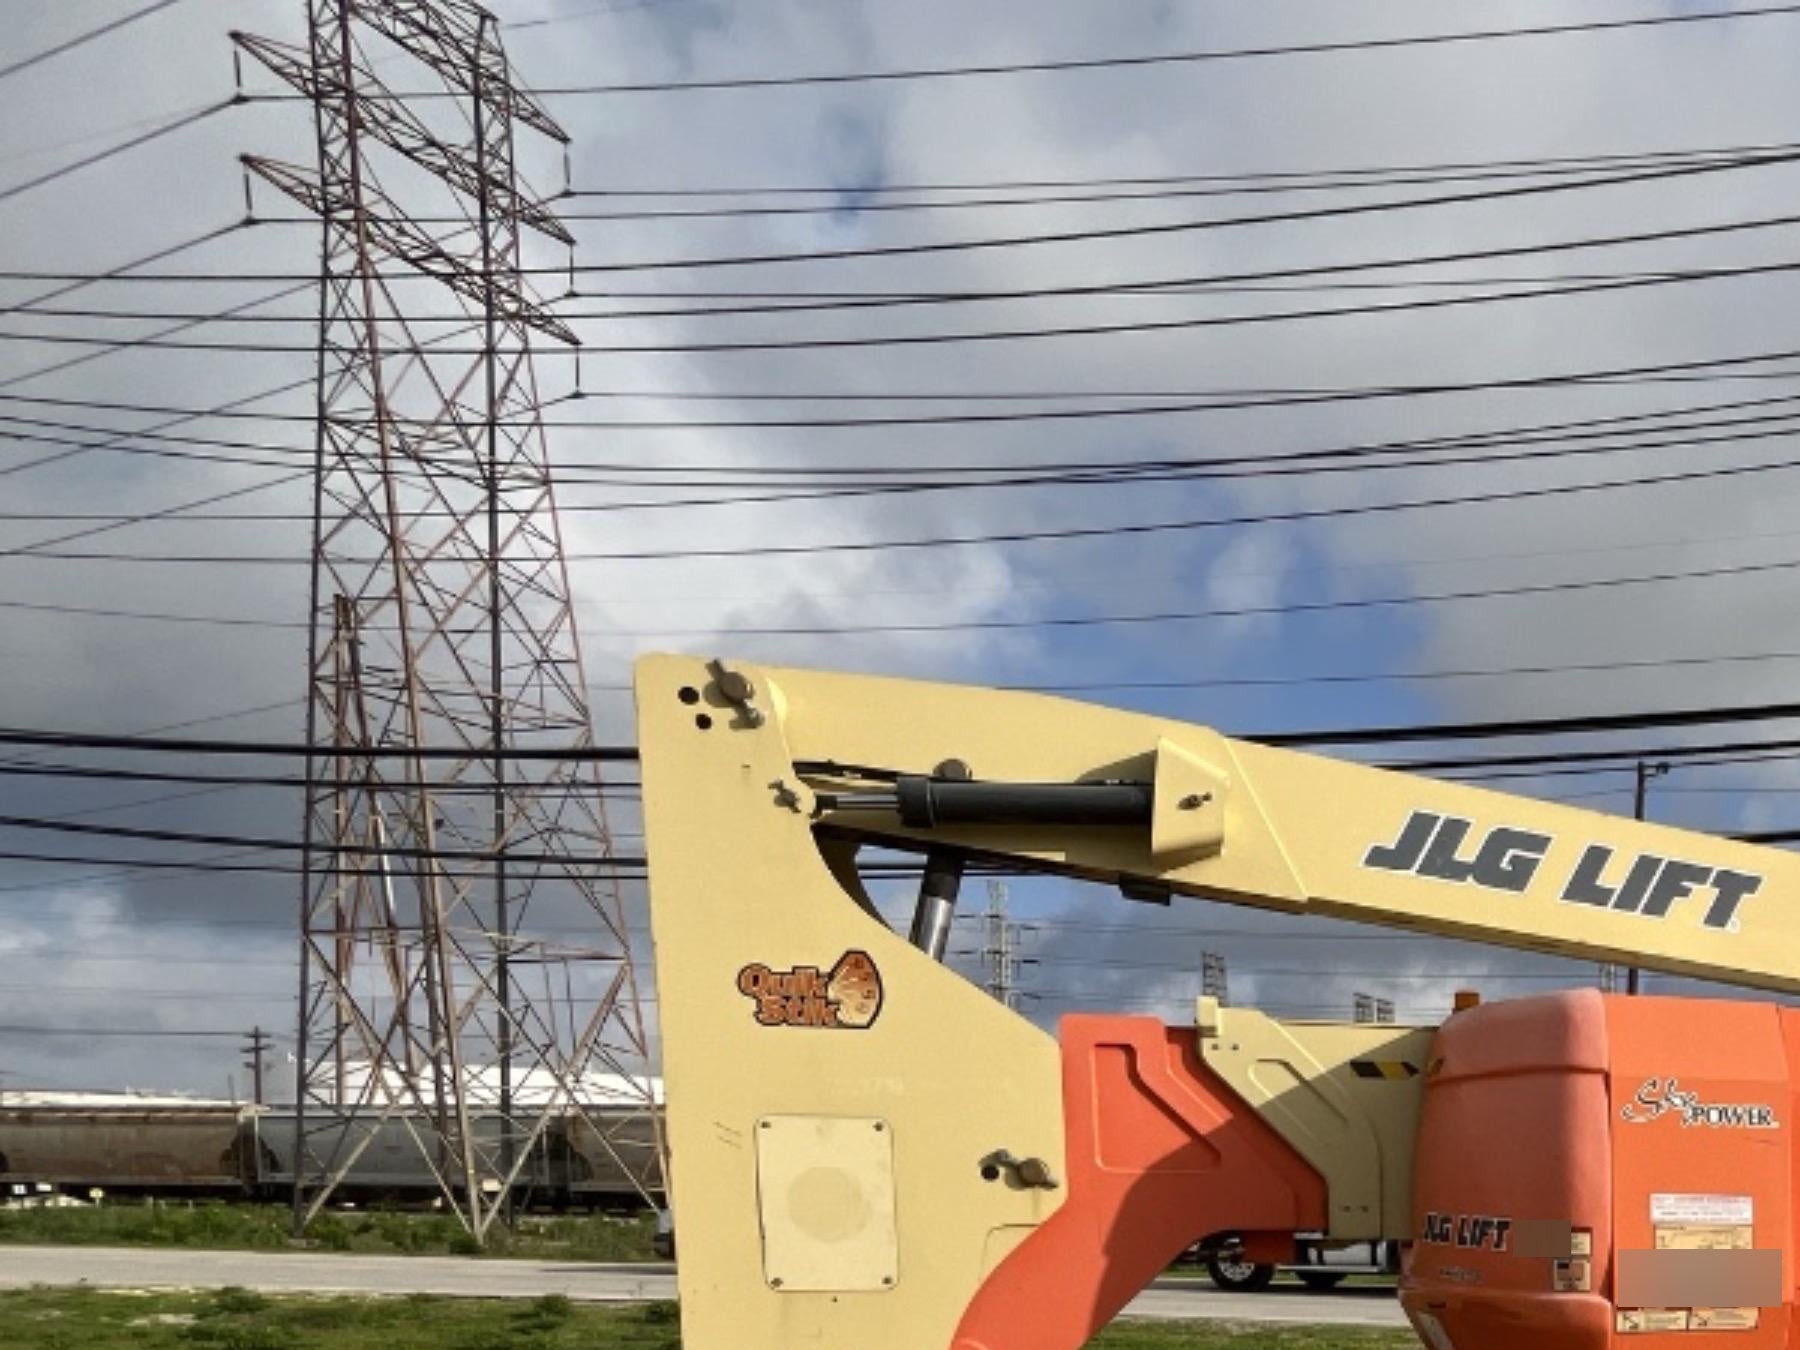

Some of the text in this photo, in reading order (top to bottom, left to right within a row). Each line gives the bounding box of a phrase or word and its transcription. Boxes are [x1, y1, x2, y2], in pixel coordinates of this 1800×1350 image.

[1364, 810, 1764, 932] JLG LIFT
[1690, 1104, 1774, 1127] POWER
[1457, 1215, 1512, 1251] LIFT
